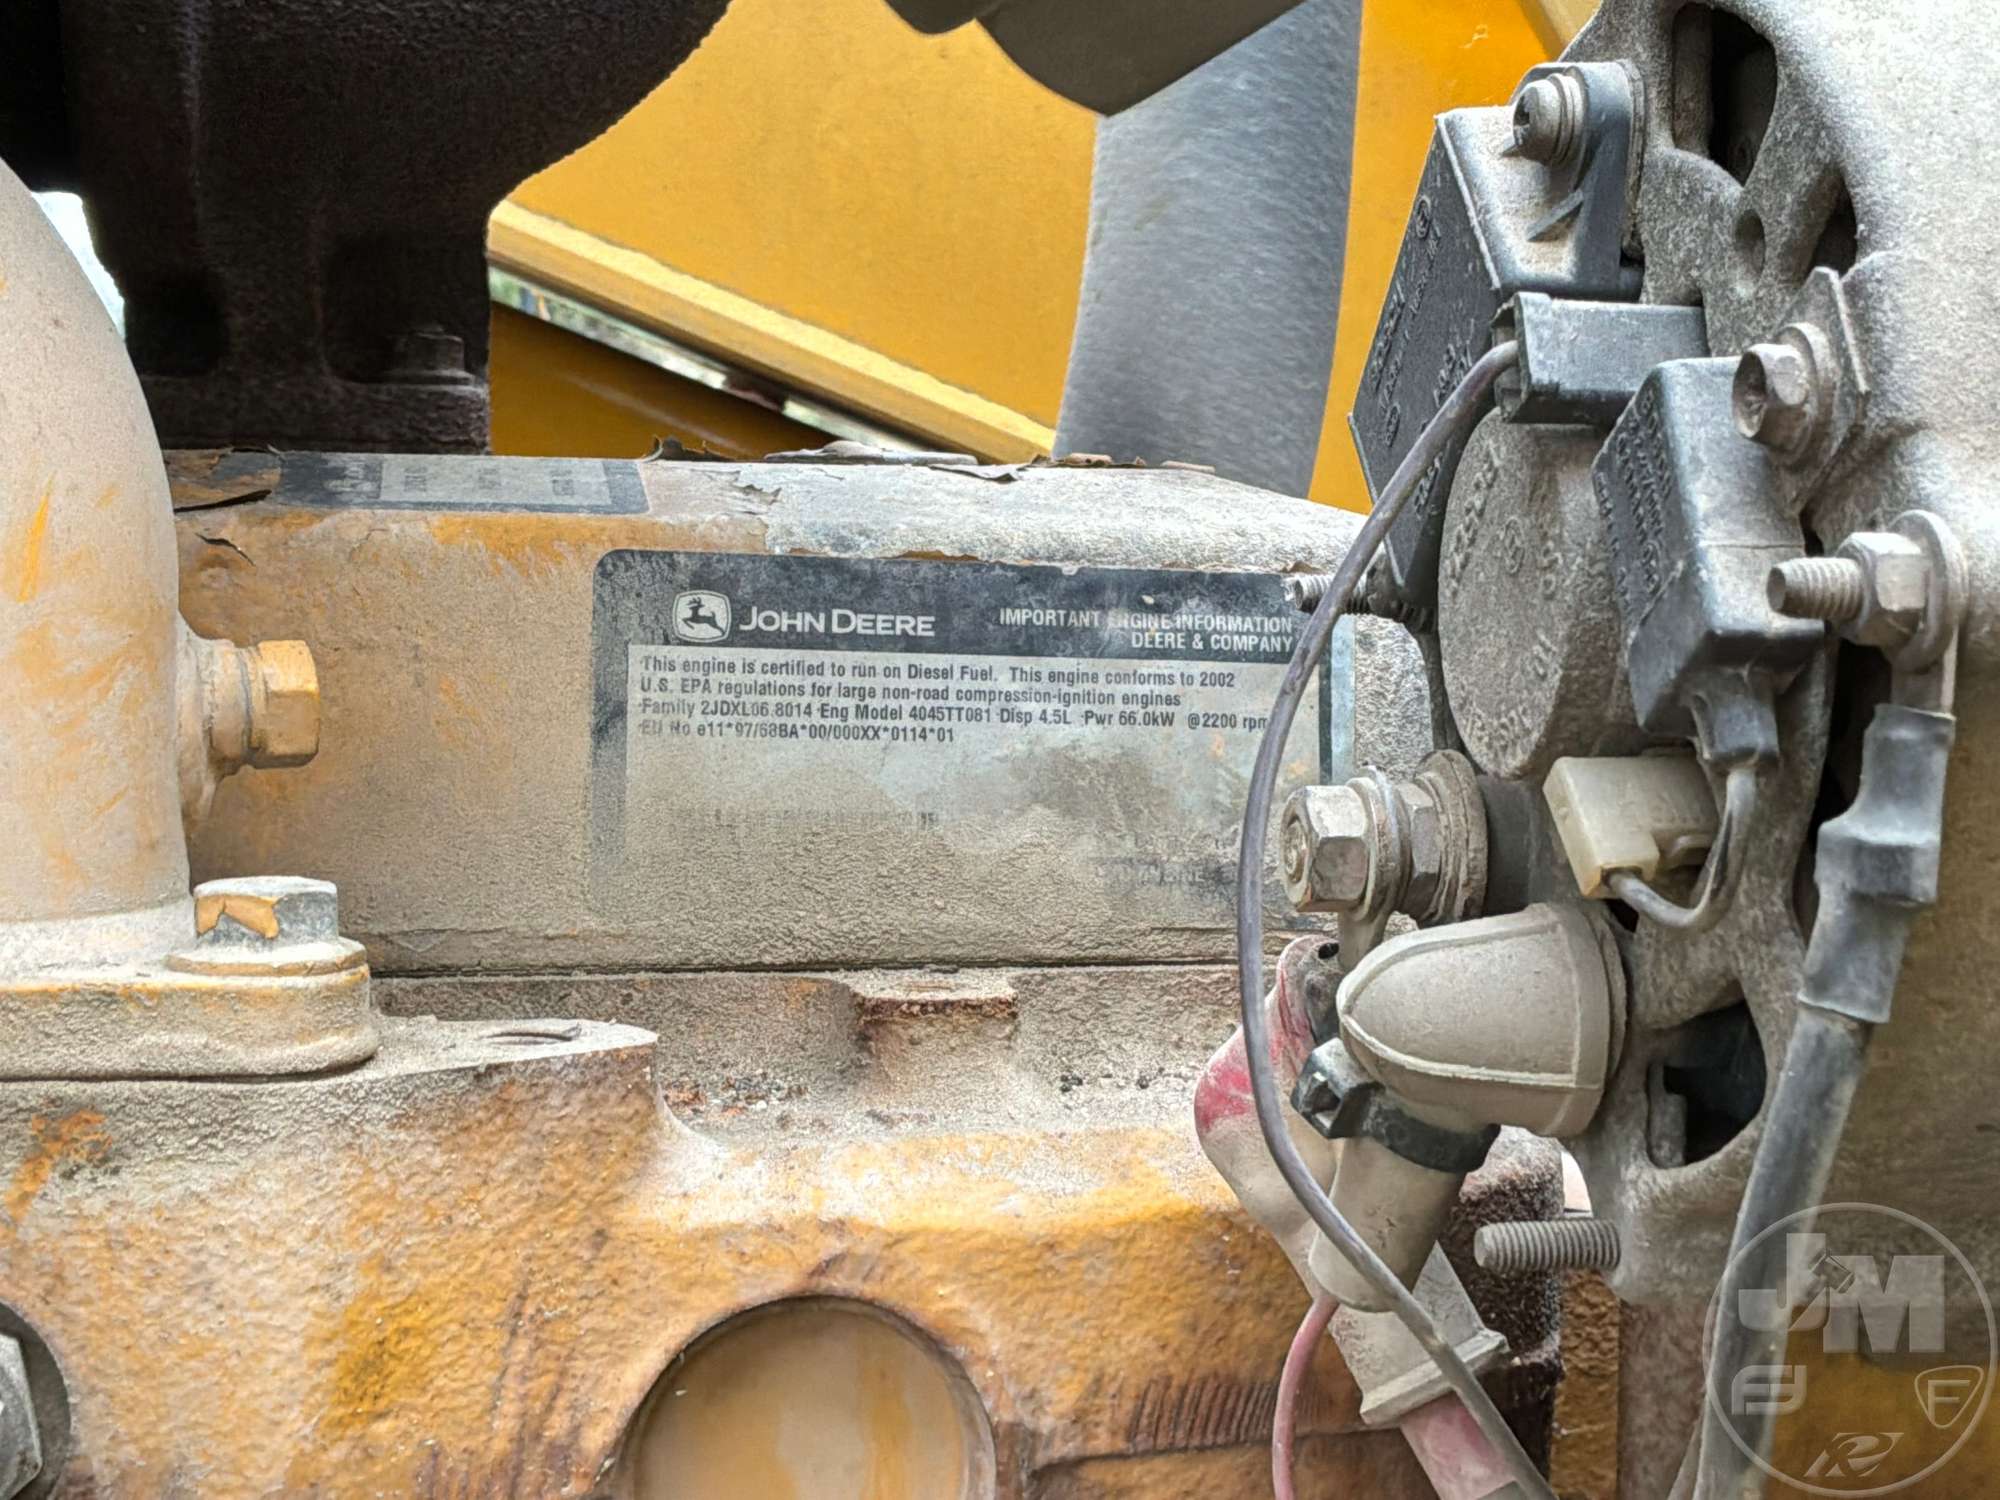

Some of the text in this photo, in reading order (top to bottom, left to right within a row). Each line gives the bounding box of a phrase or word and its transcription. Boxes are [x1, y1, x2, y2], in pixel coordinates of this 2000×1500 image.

[739, 606, 936, 637] JOHN DEERE
[1000, 607, 1100, 629] IMPORTANT
[1175, 613, 1293, 634] INFORMATION
[1131, 631, 1293, 653] DEERE & COMPANY
[641, 656, 1235, 688] This engine is certified to run on Diesel Fuel. This engine conforms to 2002
[640, 677, 1181, 710] U.S. EPA regulations for large non-road compression-ignition engines
[641, 698, 695, 718] Family
[820, 703, 849, 722] Eng
[855, 704, 903, 721] Model
[1000, 708, 1032, 727] Disp
[1039, 709, 1072, 725] 4.5L
[1084, 710, 1114, 726] Pwr
[1119, 710, 1175, 727] 66.0kW
